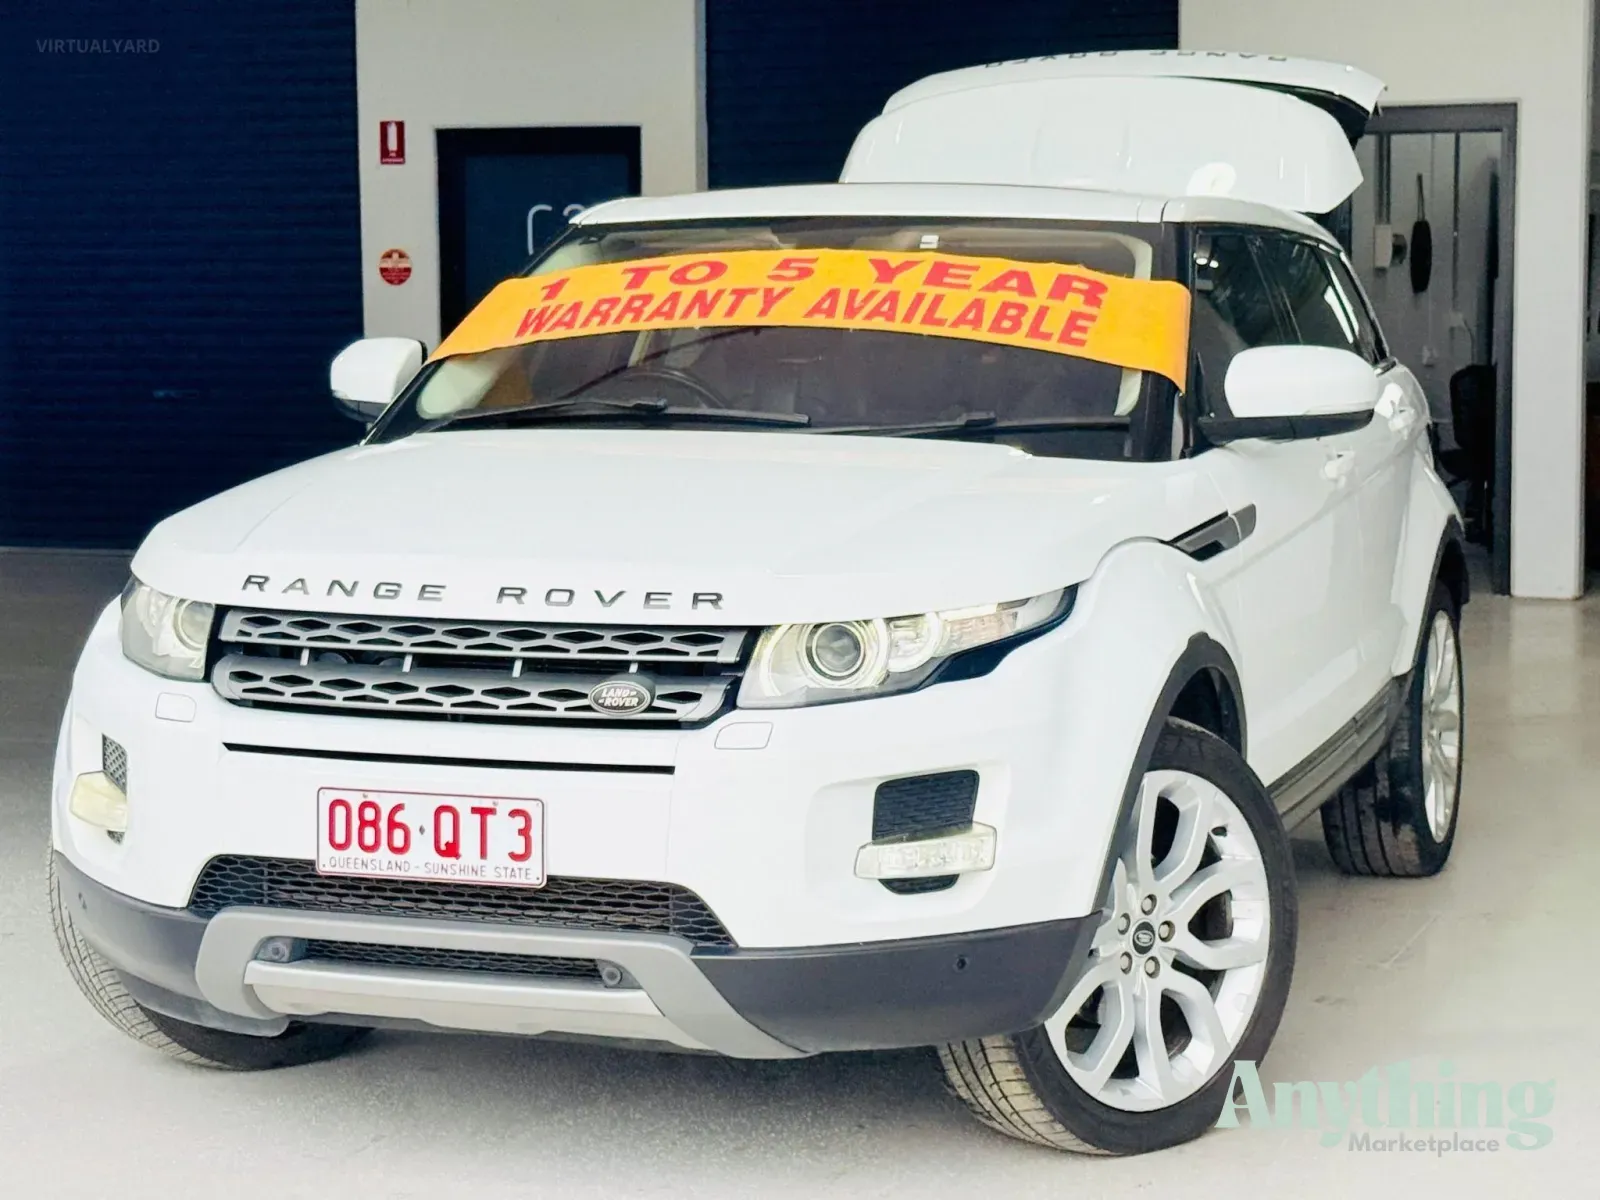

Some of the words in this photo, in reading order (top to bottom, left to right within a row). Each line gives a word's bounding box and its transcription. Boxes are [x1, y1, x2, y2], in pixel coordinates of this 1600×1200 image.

[541, 278, 570, 301] 1
[621, 260, 729, 290] TO
[767, 257, 819, 283] 5
[868, 258, 1109, 309] YEAR
[514, 286, 795, 339] WARRANTY
[802, 287, 1098, 347] AVAILABLE
[242, 574, 447, 603] RANGE
[496, 586, 725, 611] ROVER
[328, 799, 412, 856] 086
[433, 805, 533, 863] QT3
[329, 856, 411, 874] QUEENSLAND
[424, 862, 487, 879] SUNSHINE
[494, 867, 532, 881] STATE
